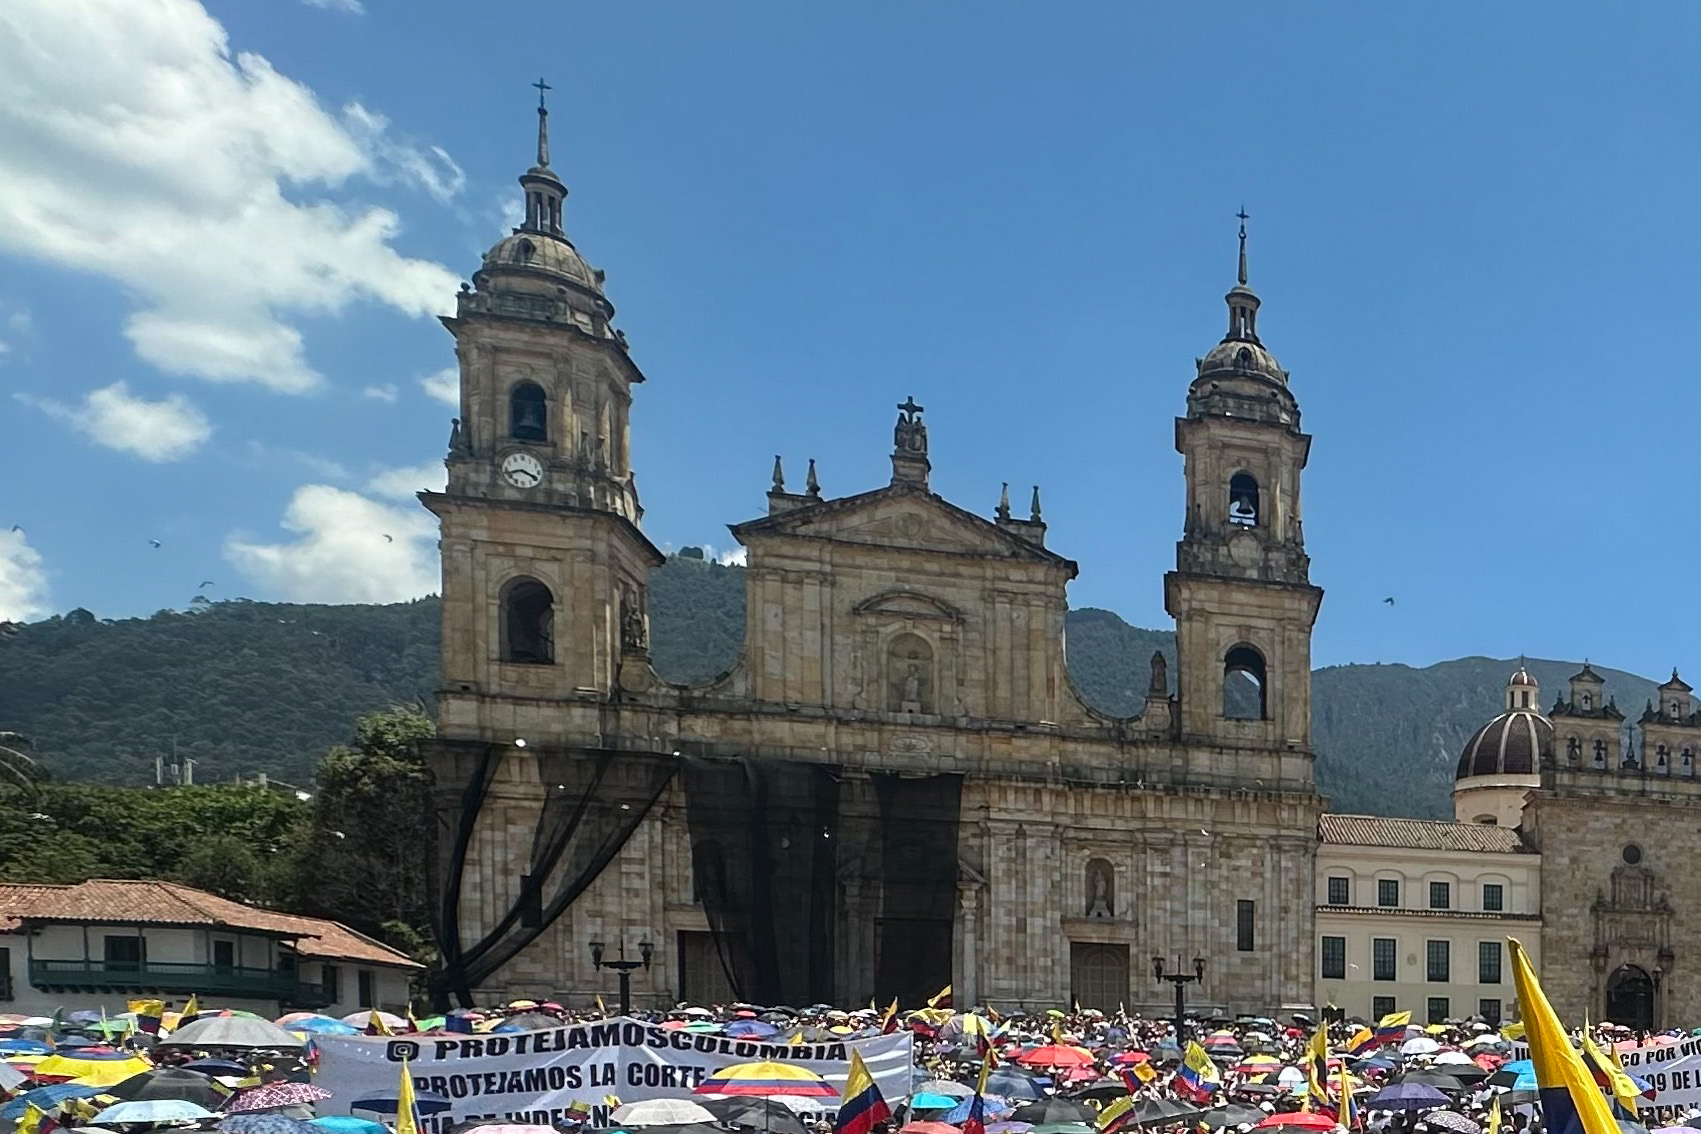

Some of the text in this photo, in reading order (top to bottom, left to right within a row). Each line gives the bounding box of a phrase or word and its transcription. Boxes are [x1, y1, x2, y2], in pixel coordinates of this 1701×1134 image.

[435, 1023, 847, 1061] PROTEJAMOSCOLOMBIA
[1645, 1046, 1677, 1065] POR
[413, 1064, 582, 1099] PROTEJAMOS
[592, 1064, 617, 1086] LA
[627, 1066, 706, 1088] CORTE
[1671, 1071, 1692, 1091] DE
